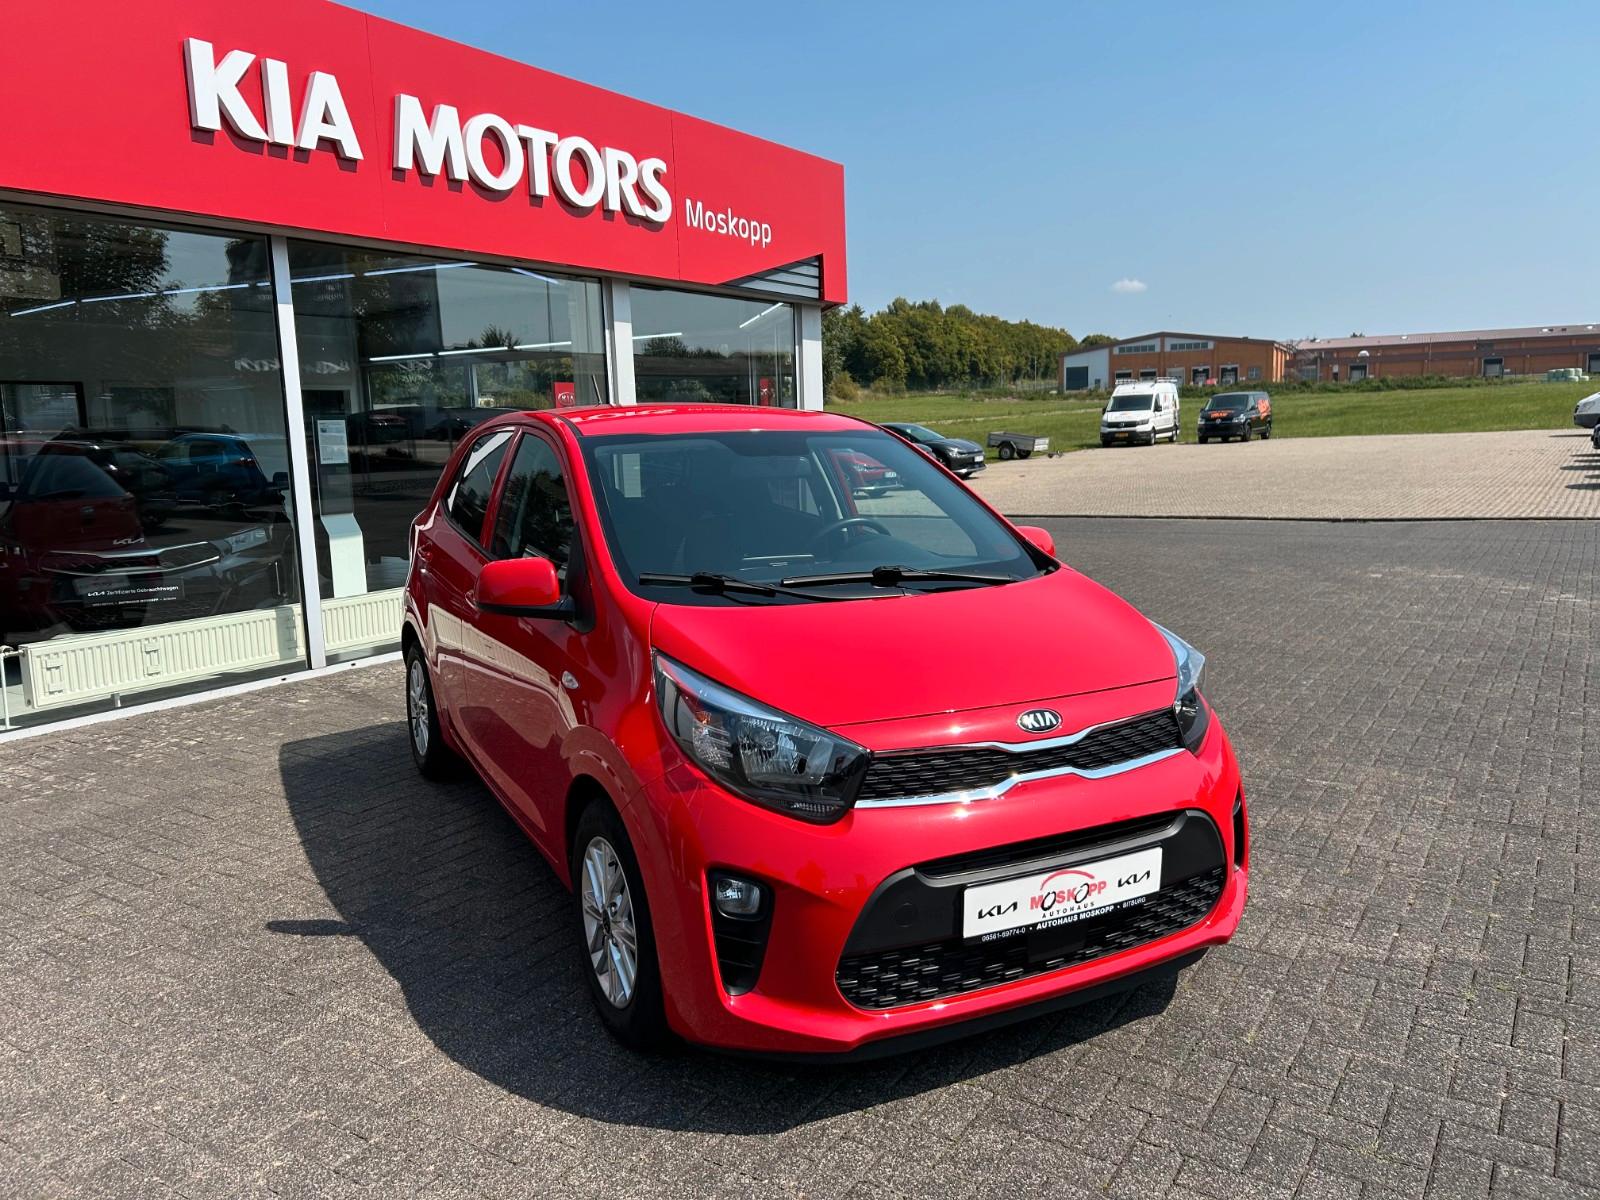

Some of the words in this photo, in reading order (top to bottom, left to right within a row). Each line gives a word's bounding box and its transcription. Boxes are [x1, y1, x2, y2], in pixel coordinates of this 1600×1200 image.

[184, 37, 364, 161] KIA
[393, 93, 672, 224] MOTORS
[685, 198, 773, 248] Moskopp
[1021, 711, 1057, 729] KIA
[1117, 870, 1151, 888] KIA
[1029, 880, 1107, 912] MOSKOPP
[977, 901, 1018, 920] KIA
[1036, 914, 1078, 931] AUTOHAUS
[1079, 904, 1114, 920] MOSKOPP
[1122, 896, 1146, 909] BITBURG
[1041, 901, 1095, 919] AUTOHAUS
